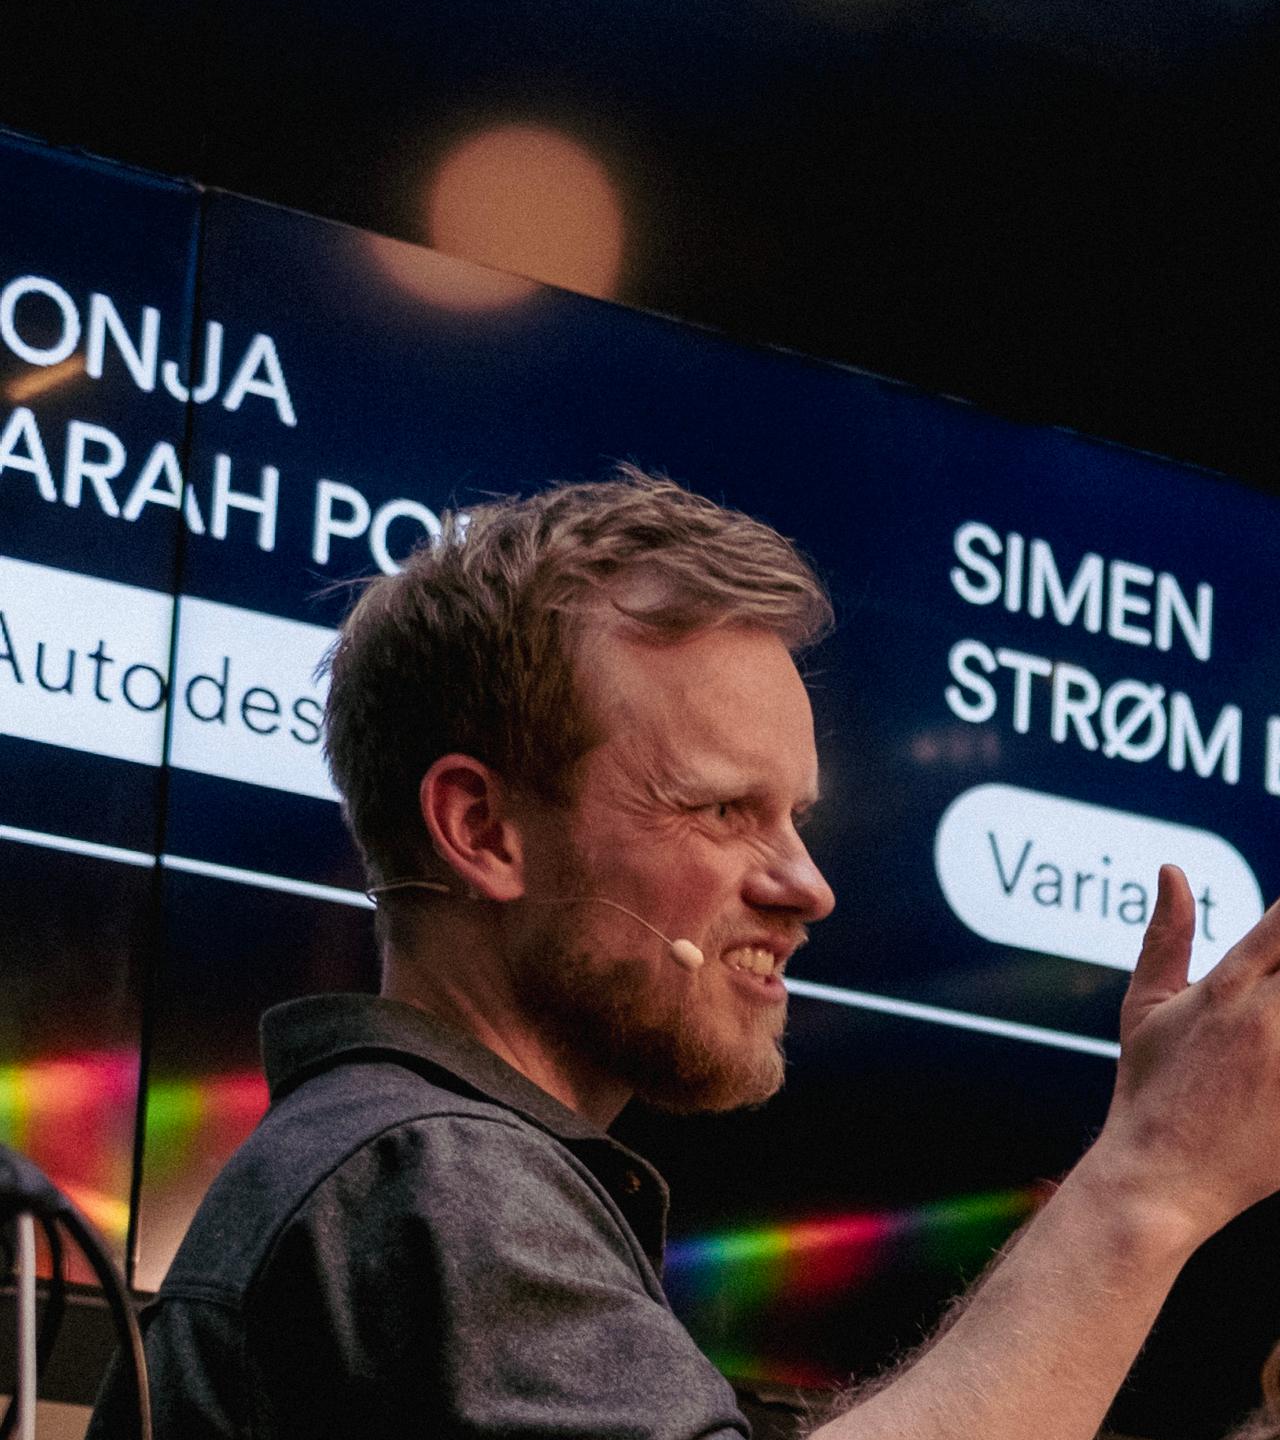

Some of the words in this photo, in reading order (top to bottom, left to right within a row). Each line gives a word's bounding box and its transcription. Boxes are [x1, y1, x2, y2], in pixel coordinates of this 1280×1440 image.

[0, 275, 298, 428] ONJA
[0, 406, 280, 553] ARAH
[312, 478, 472, 577] PO
[951, 521, 1214, 662] SIMEN
[945, 639, 1243, 785] STRØM
[987, 830, 1217, 943] Variat
